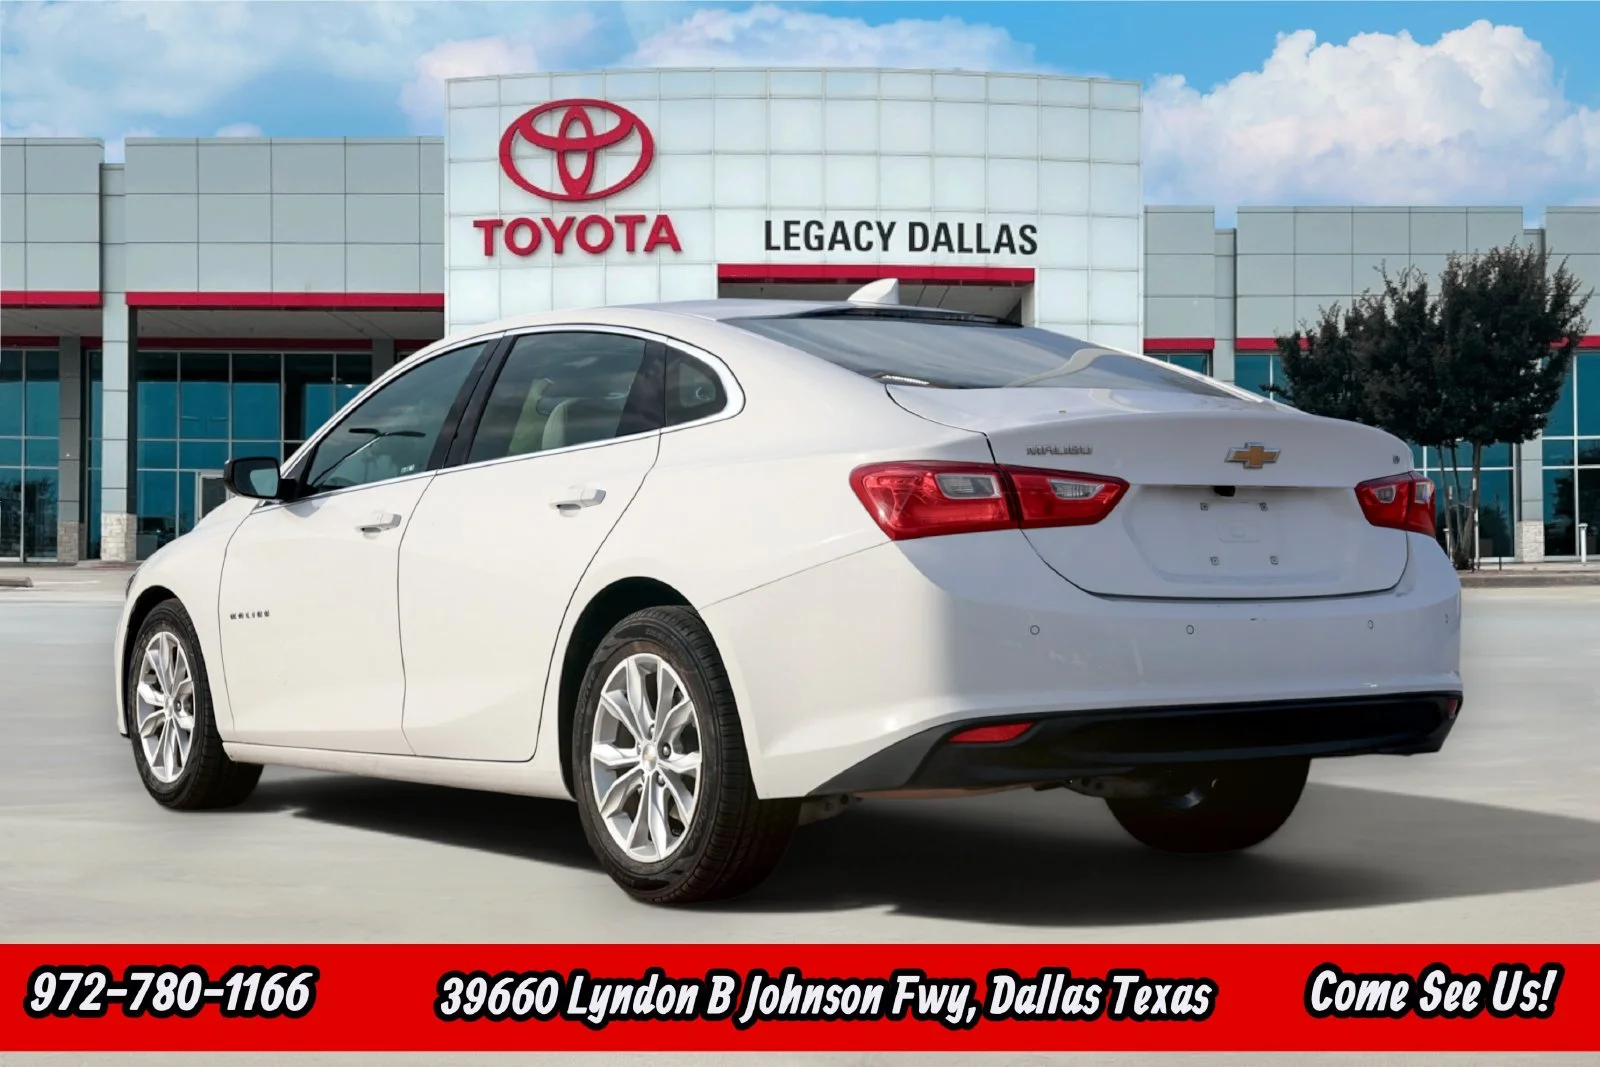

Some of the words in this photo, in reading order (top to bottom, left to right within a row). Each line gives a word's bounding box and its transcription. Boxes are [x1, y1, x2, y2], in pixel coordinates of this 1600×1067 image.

[473, 214, 682, 257] TOYOTA
[765, 220, 896, 252] LEGACY
[908, 221, 1038, 255] DALLAS
